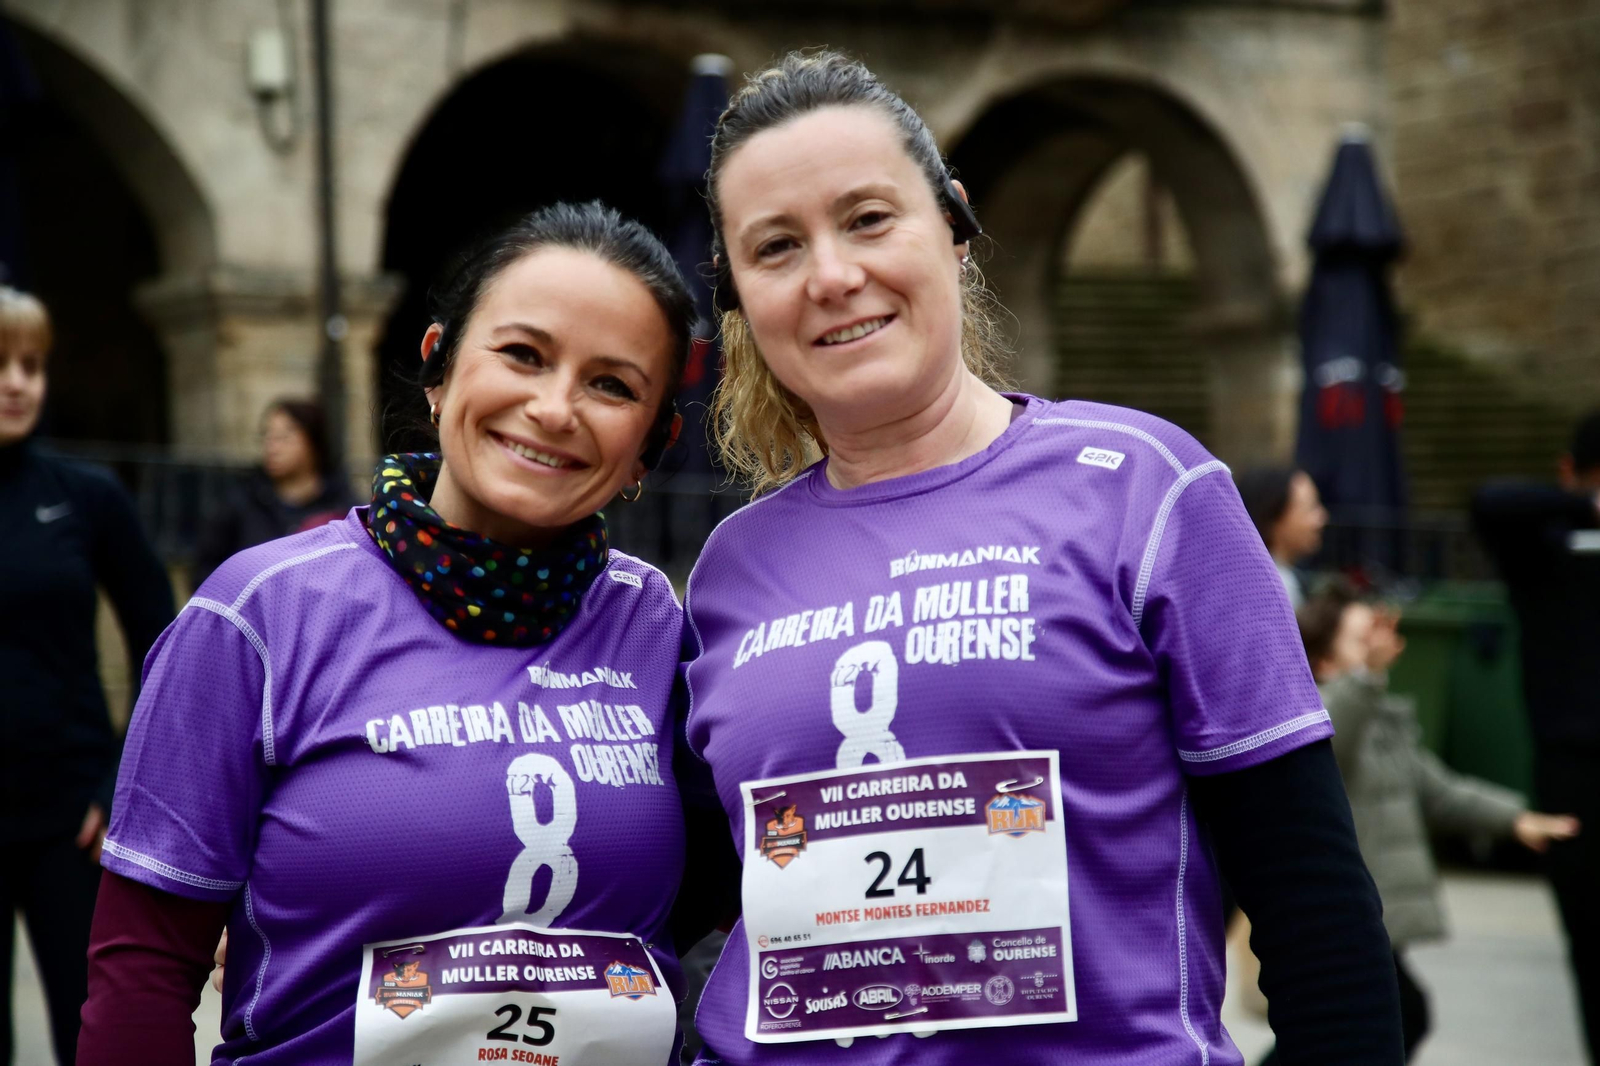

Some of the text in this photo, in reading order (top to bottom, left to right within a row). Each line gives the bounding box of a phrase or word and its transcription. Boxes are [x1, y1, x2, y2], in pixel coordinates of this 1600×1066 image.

[890, 545, 1040, 579] RUNMANIAK
[732, 574, 1030, 670] CARREIRA DA MULLER
[905, 618, 1036, 665] OURENSE
[365, 699, 656, 754] CARREIRA DA MULLER
[820, 771, 968, 804] VII CARREIRA DA
[814, 797, 977, 831] MULLER OURENSE
[864, 847, 932, 900] 24
[815, 898, 991, 926] MONTSE MONTES FERNANDEZ
[448, 939, 585, 959] VII CARREIRA DA
[992, 935, 1047, 948] Concello de
[829, 947, 906, 970] ABANCA
[924, 954, 956, 964] inorde
[992, 945, 1057, 962] OURENSE
[441, 965, 597, 985] MULLER OURENSE
[763, 996, 799, 1006] NISSAN
[859, 988, 898, 1005] ABRIL
[921, 983, 982, 997] AODEMPER
[486, 1003, 557, 1047] 25
[477, 1047, 560, 1066] ROSA SEOANE
